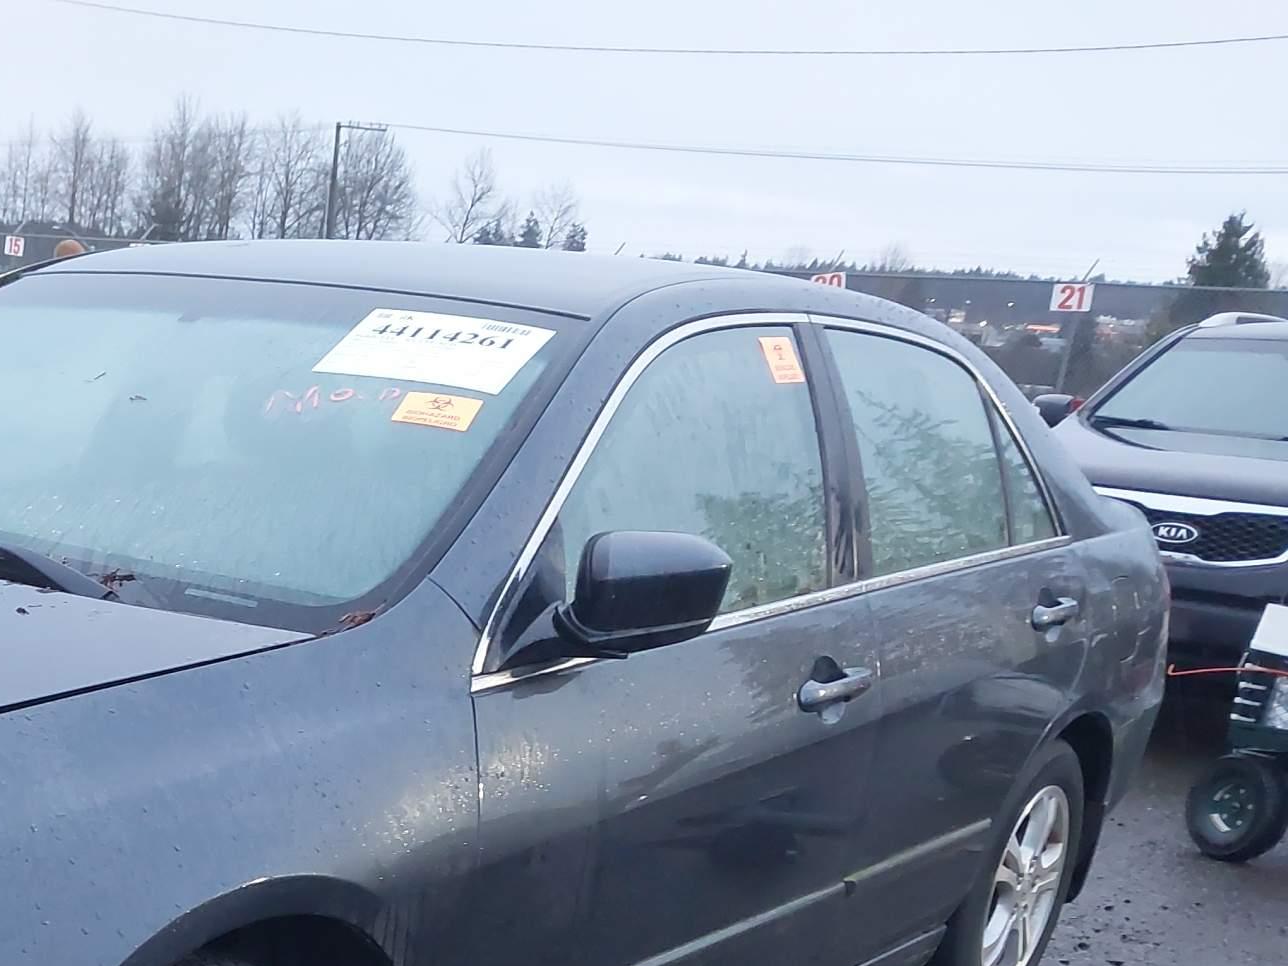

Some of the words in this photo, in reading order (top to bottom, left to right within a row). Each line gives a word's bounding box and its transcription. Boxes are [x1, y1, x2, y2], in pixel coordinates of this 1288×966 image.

[8, 238, 21, 254] 15
[1057, 285, 1085, 310] 21
[372, 323, 515, 350] 44114261
[1158, 526, 1188, 539] KIA
